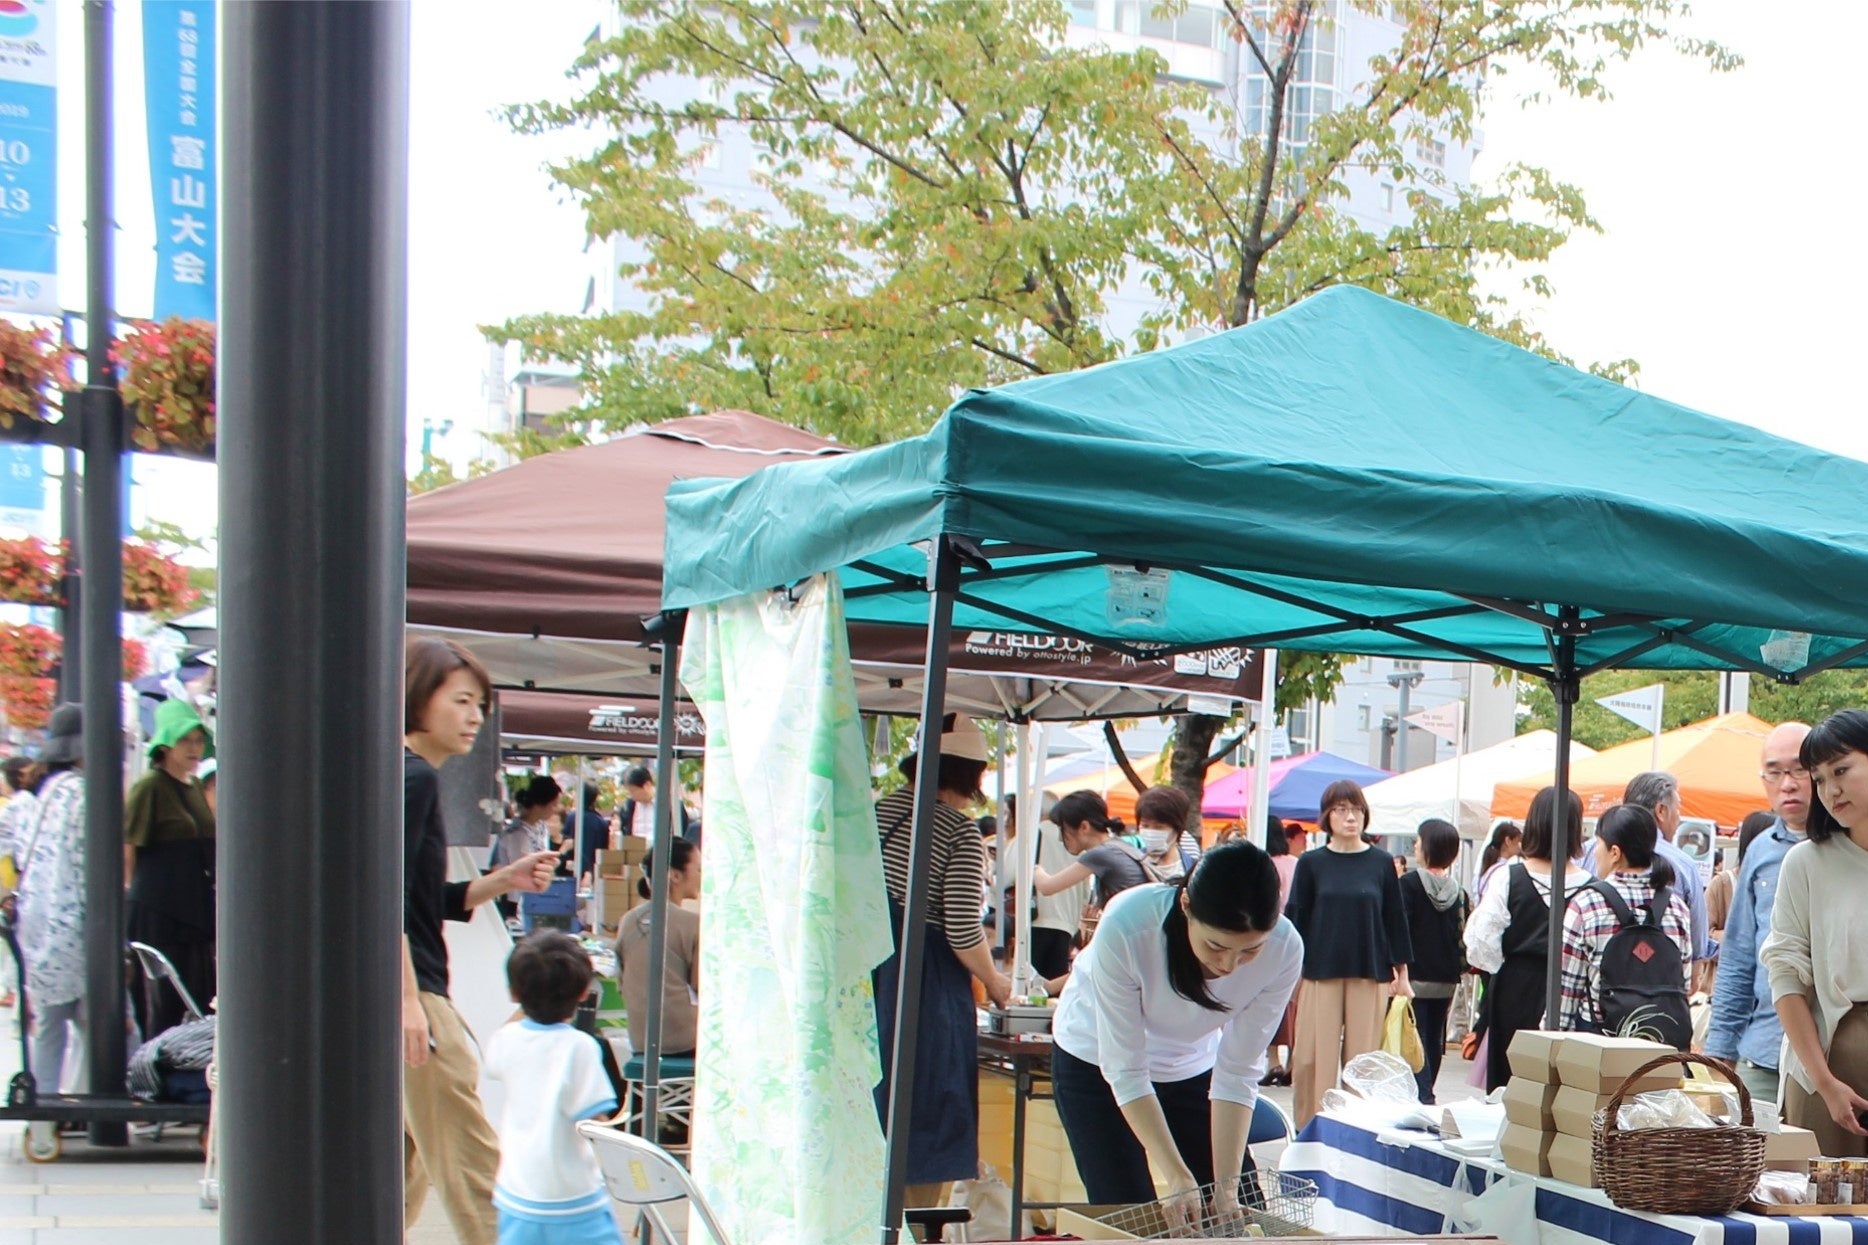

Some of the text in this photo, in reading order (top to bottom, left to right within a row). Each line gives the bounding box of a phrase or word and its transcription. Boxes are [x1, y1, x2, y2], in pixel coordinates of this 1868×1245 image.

[170, 134, 206, 285] 富山大会
[965, 643, 1092, 666] Powered by ottostyle.jp
